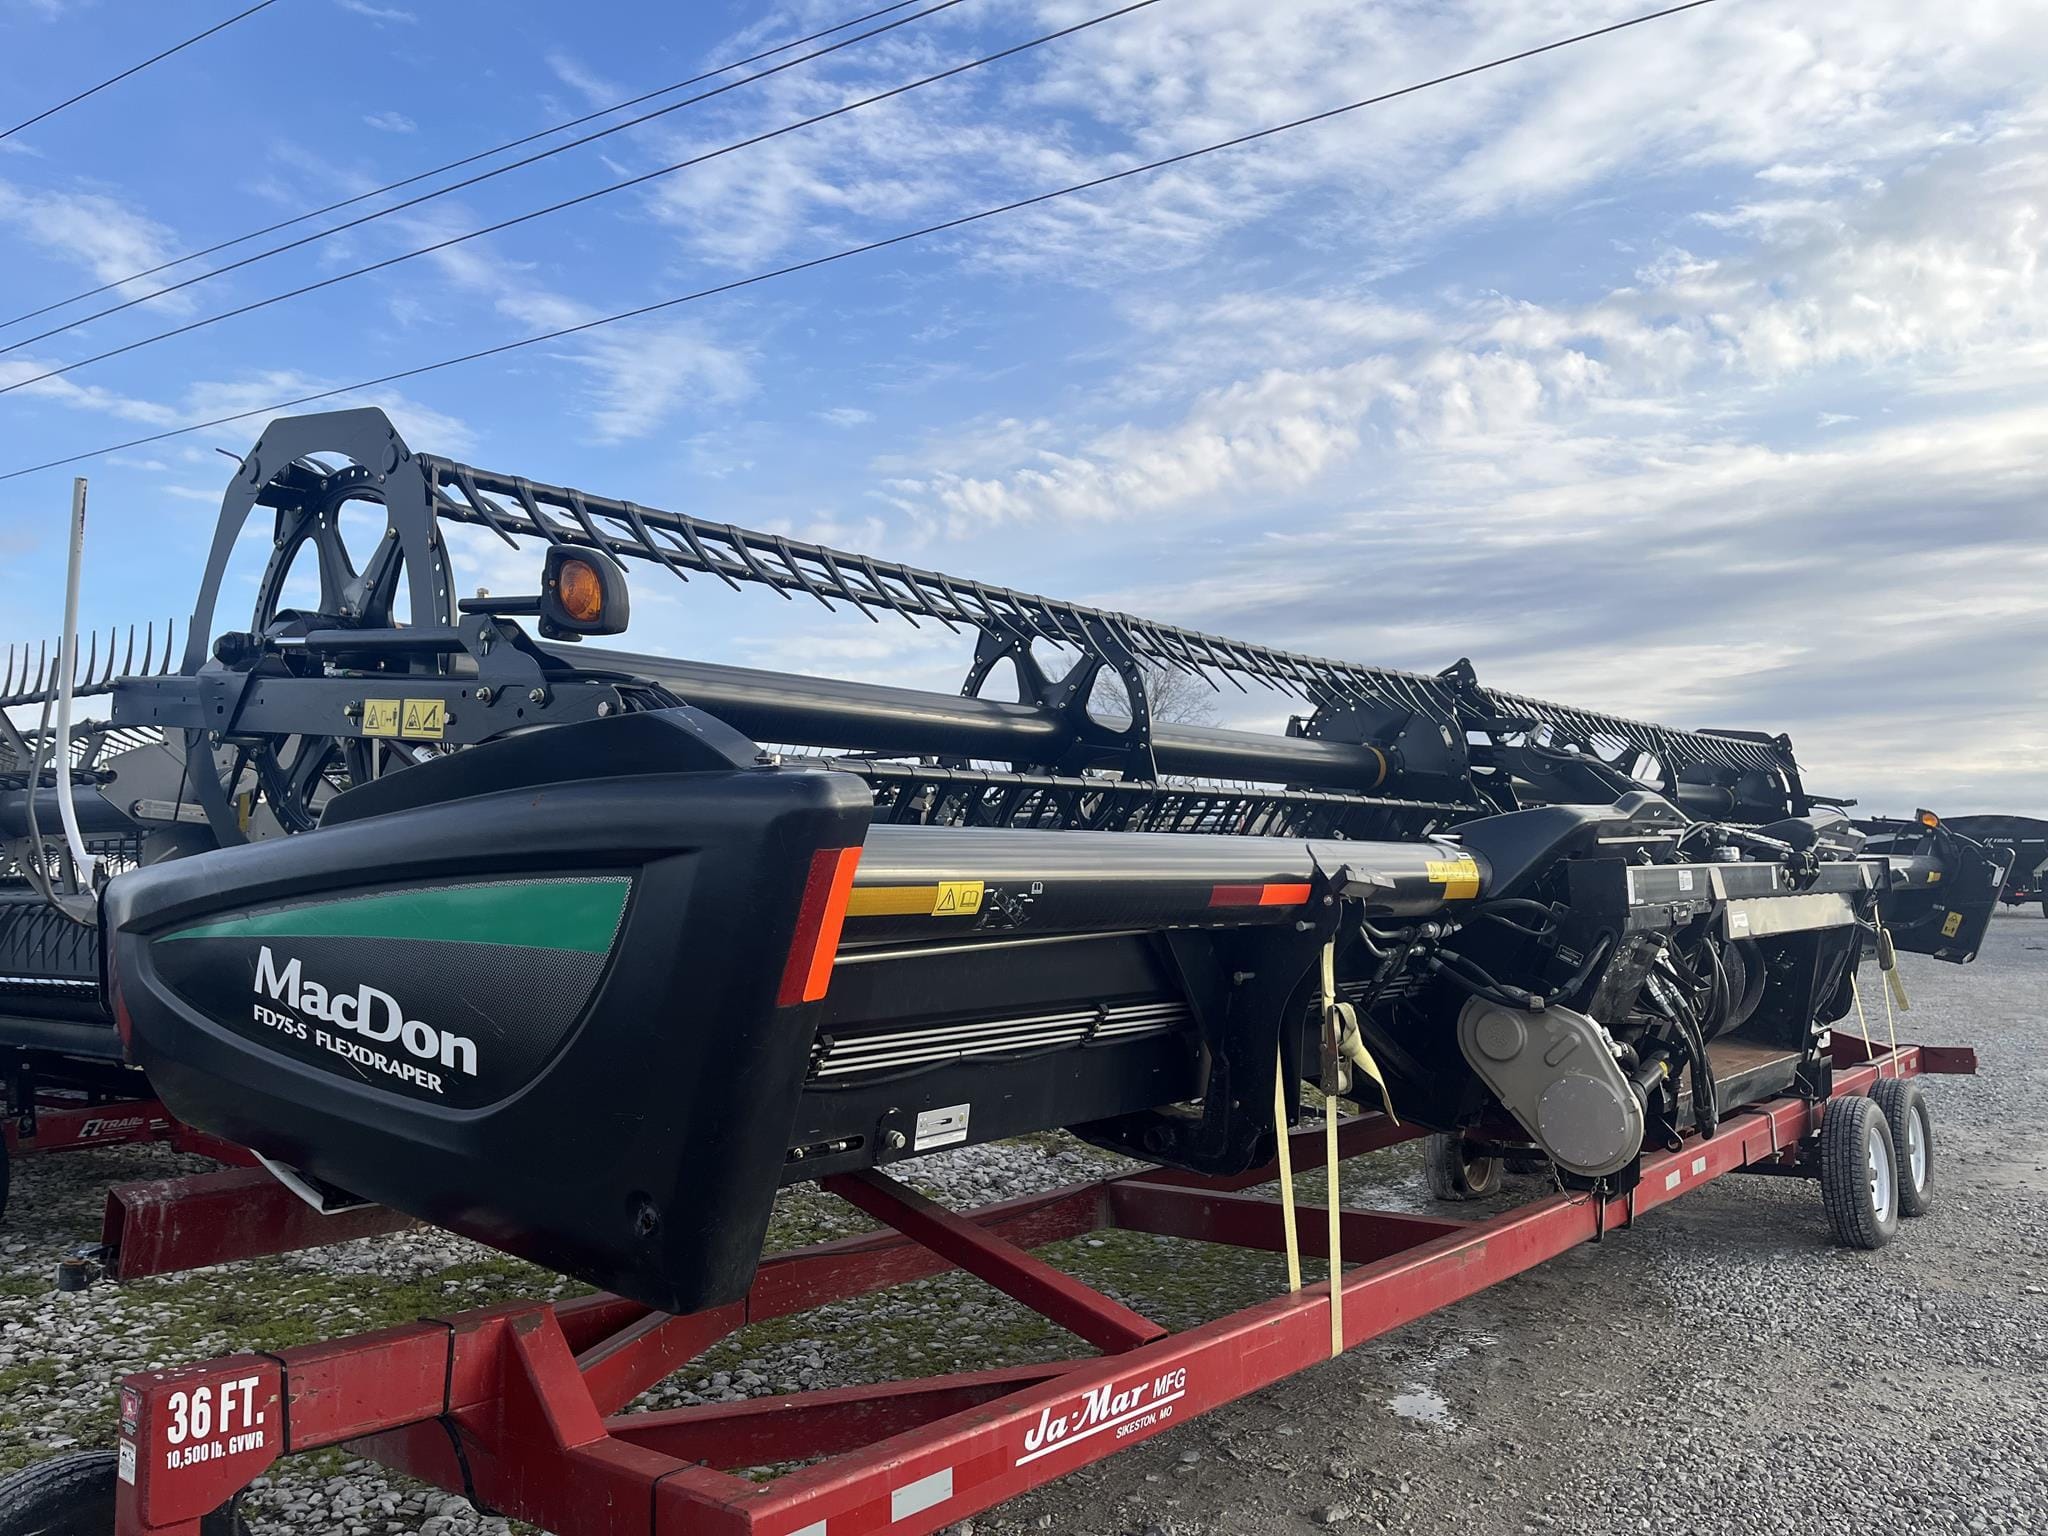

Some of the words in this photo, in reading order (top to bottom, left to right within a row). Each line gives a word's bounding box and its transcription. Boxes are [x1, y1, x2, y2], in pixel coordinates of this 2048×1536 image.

[254, 945, 477, 1076] MacDon
[253, 1004, 307, 1040] FD75-S
[315, 1029, 443, 1093] FLEXDRAPER
[1152, 1367, 1186, 1398] MFG
[167, 1387, 212, 1444] 36
[220, 1376, 264, 1433] FT.
[1116, 1412, 1157, 1439] SIKESTON,
[1160, 1405, 1173, 1420] MO
[166, 1443, 209, 1469] 10,500
[211, 1440, 226, 1459] lb.
[229, 1430, 264, 1454] GVWR
